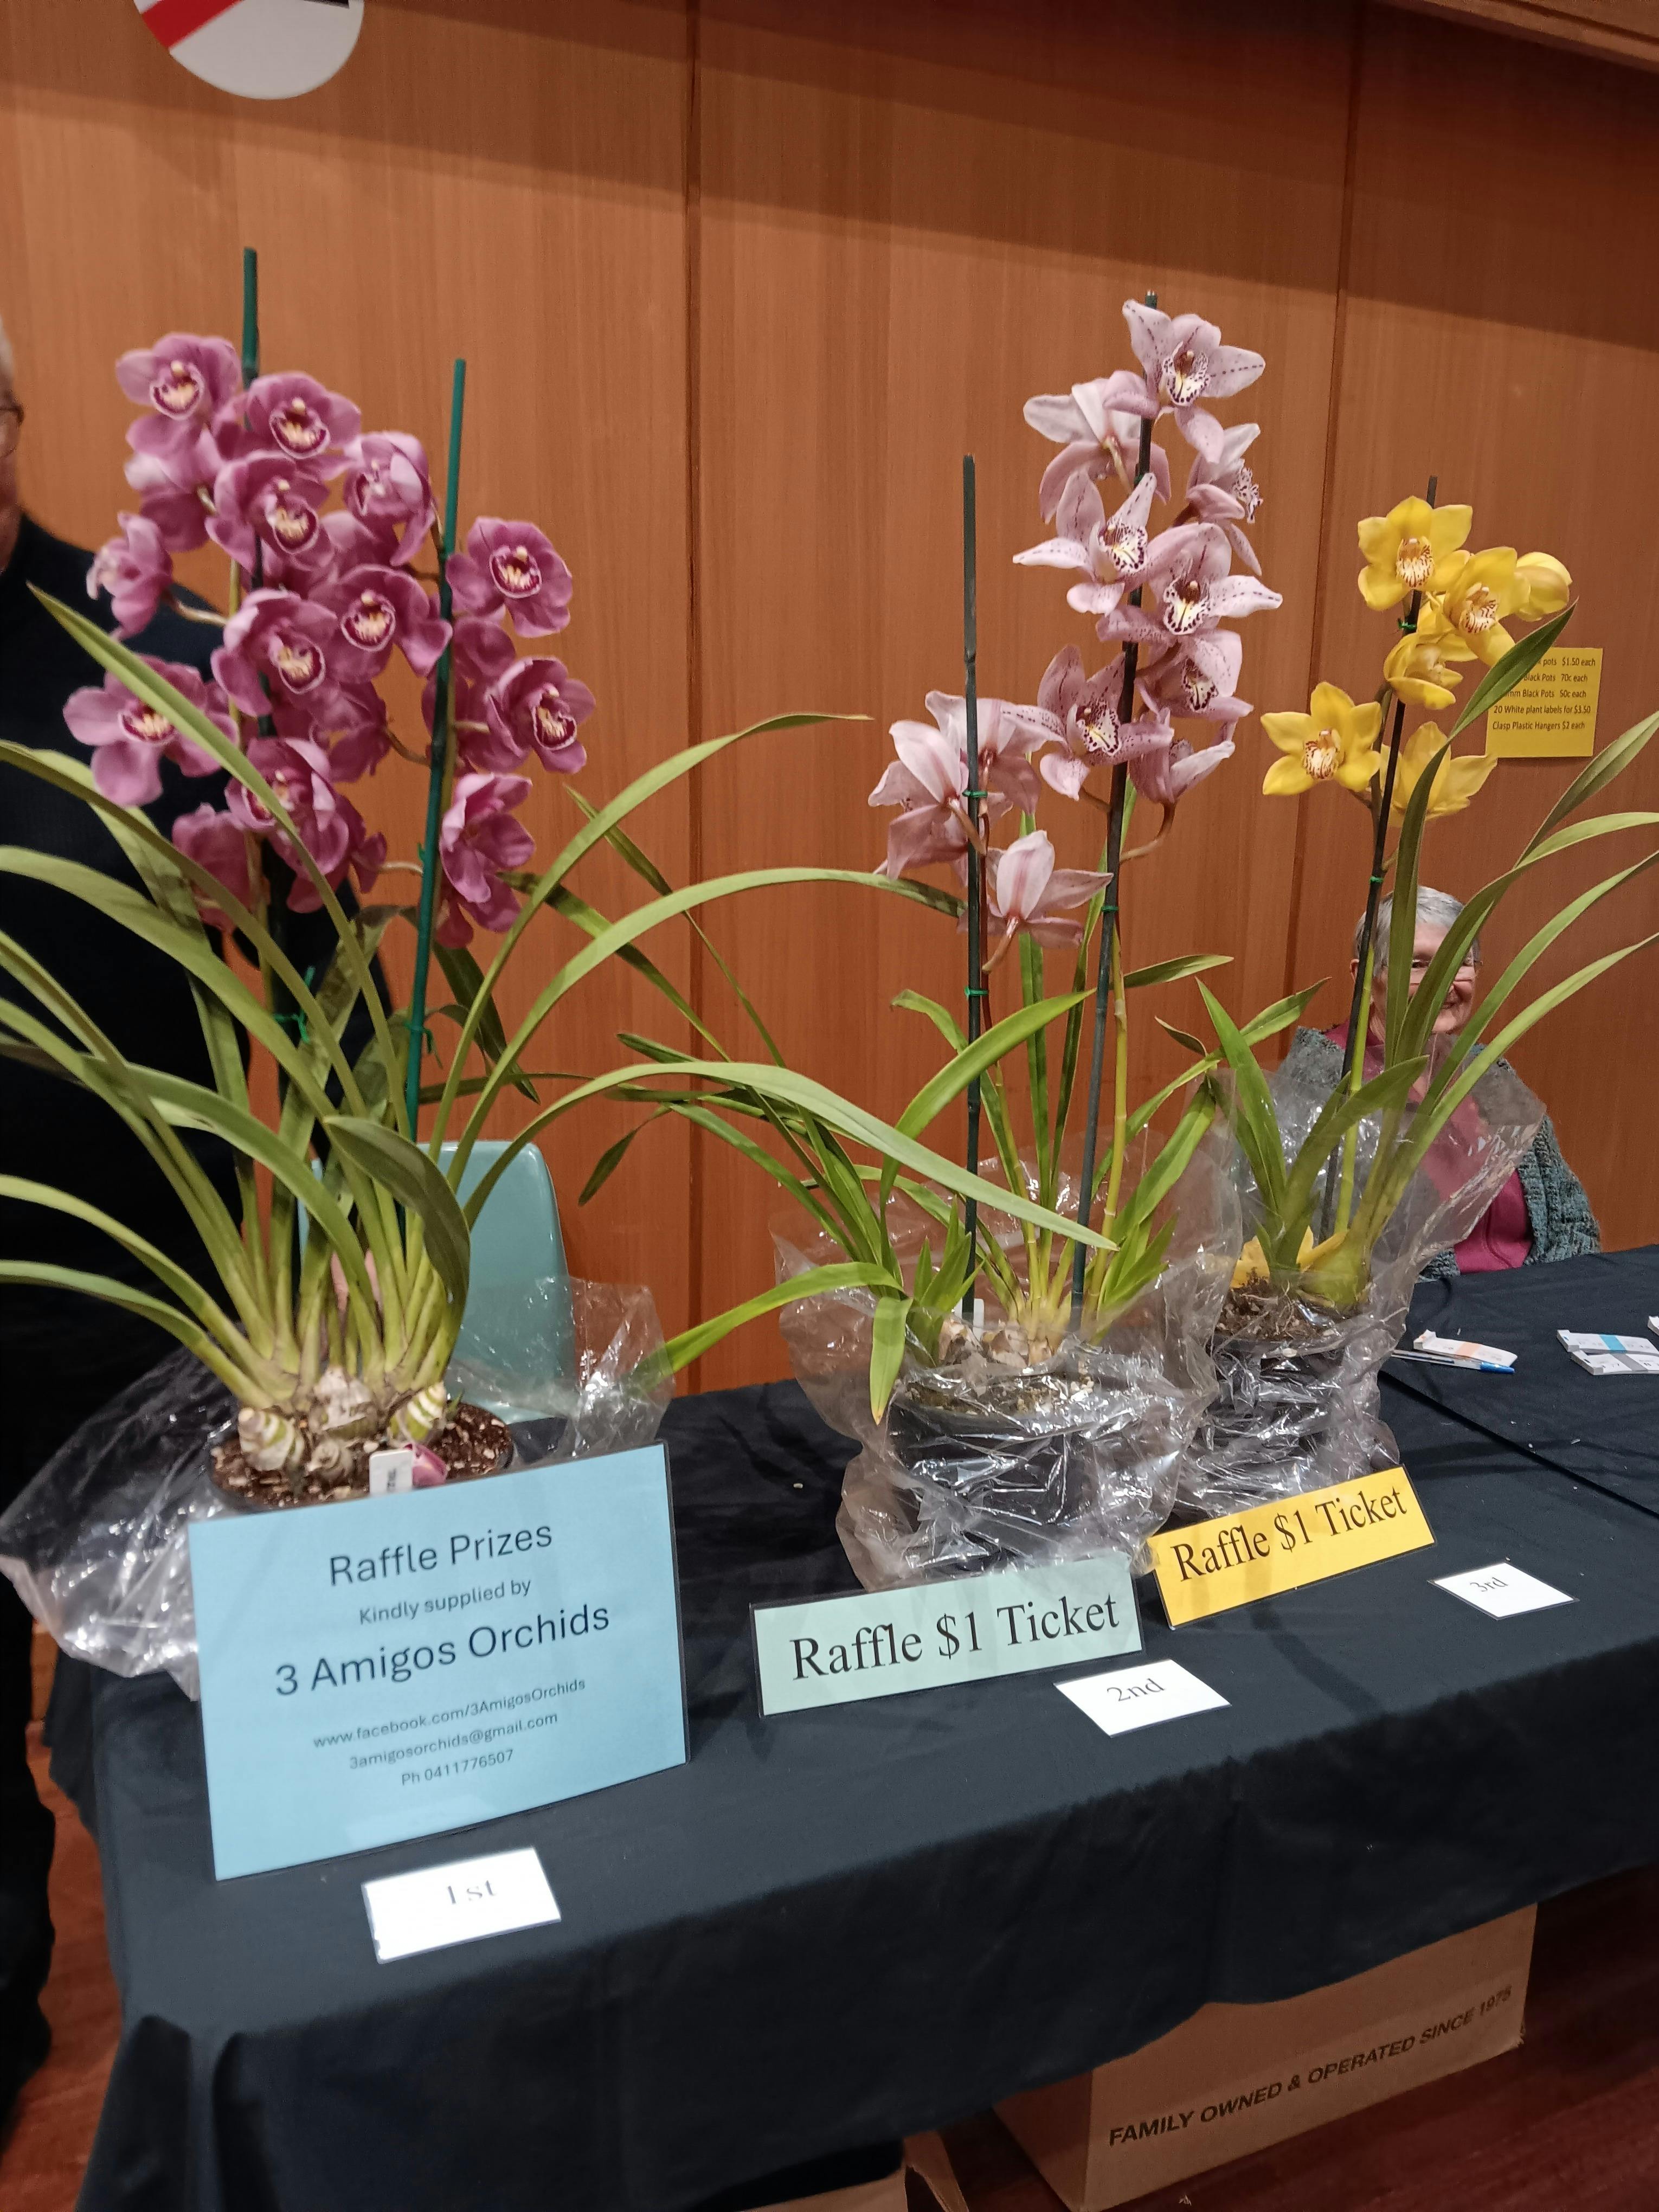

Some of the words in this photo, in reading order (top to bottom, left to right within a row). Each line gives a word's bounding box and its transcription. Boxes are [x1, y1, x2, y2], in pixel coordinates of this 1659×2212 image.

[1543, 658, 1557, 667] pots
[1562, 657, 1579, 666] $1.50
[1581, 658, 1596, 666] each
[1561, 674, 1572, 682] 70c
[1573, 674, 1588, 683] each
[1494, 705, 1503, 713] 20
[1504, 705, 1525, 713] White
[1526, 705, 1542, 715] plant
[1544, 705, 1562, 714] labels
[1564, 705, 1573, 713] for
[1574, 705, 1591, 714] $3.50
[1522, 689, 1539, 698] Black
[1541, 690, 1554, 698] Pots
[1572, 690, 1586, 698] each
[1493, 721, 1510, 731] Clasp
[1512, 721, 1533, 730] Plastic
[1534, 721, 1560, 731] Hangers
[1562, 721, 1570, 730] $2
[1571, 721, 1585, 730] each
[1170, 1525, 1271, 1582] Raffle
[1273, 1510, 1312, 1553] $1
[1314, 1486, 1408, 1537] Ticket
[330, 1544, 438, 1586] Raffle
[450, 1525, 553, 1565] Prizes
[359, 1599, 420, 1625] Kindly
[424, 1586, 505, 1613] supplied
[510, 1578, 531, 1596] by
[1469, 1576, 1509, 1594] 3rd
[275, 1664, 299, 1696] 3
[310, 1640, 457, 1692] Amigos
[468, 1604, 611, 1658] Orchids
[789, 1622, 924, 1681] Raffle
[936, 1610, 983, 1660] $1
[996, 1593, 1120, 1648] Ticket
[1107, 1677, 1166, 1702] 2nd
[313, 1678, 586, 1748] www.facebook.com/3AmigosOrchids
[350, 1712, 558, 1770] 3amigosorchids@gmail.com
[401, 1772, 421, 1786] Ph
[423, 1749, 514, 1782] 0411776507
[447, 1879, 497, 1905] 1st
[1109, 2109, 1194, 2146] FAMILY
[1200, 2082, 1283, 2123] OWNED
[1289, 2074, 1302, 2089] &
[1308, 2035, 1416, 2085] OPERATED
[1419, 2009, 1475, 2046] SINCE
